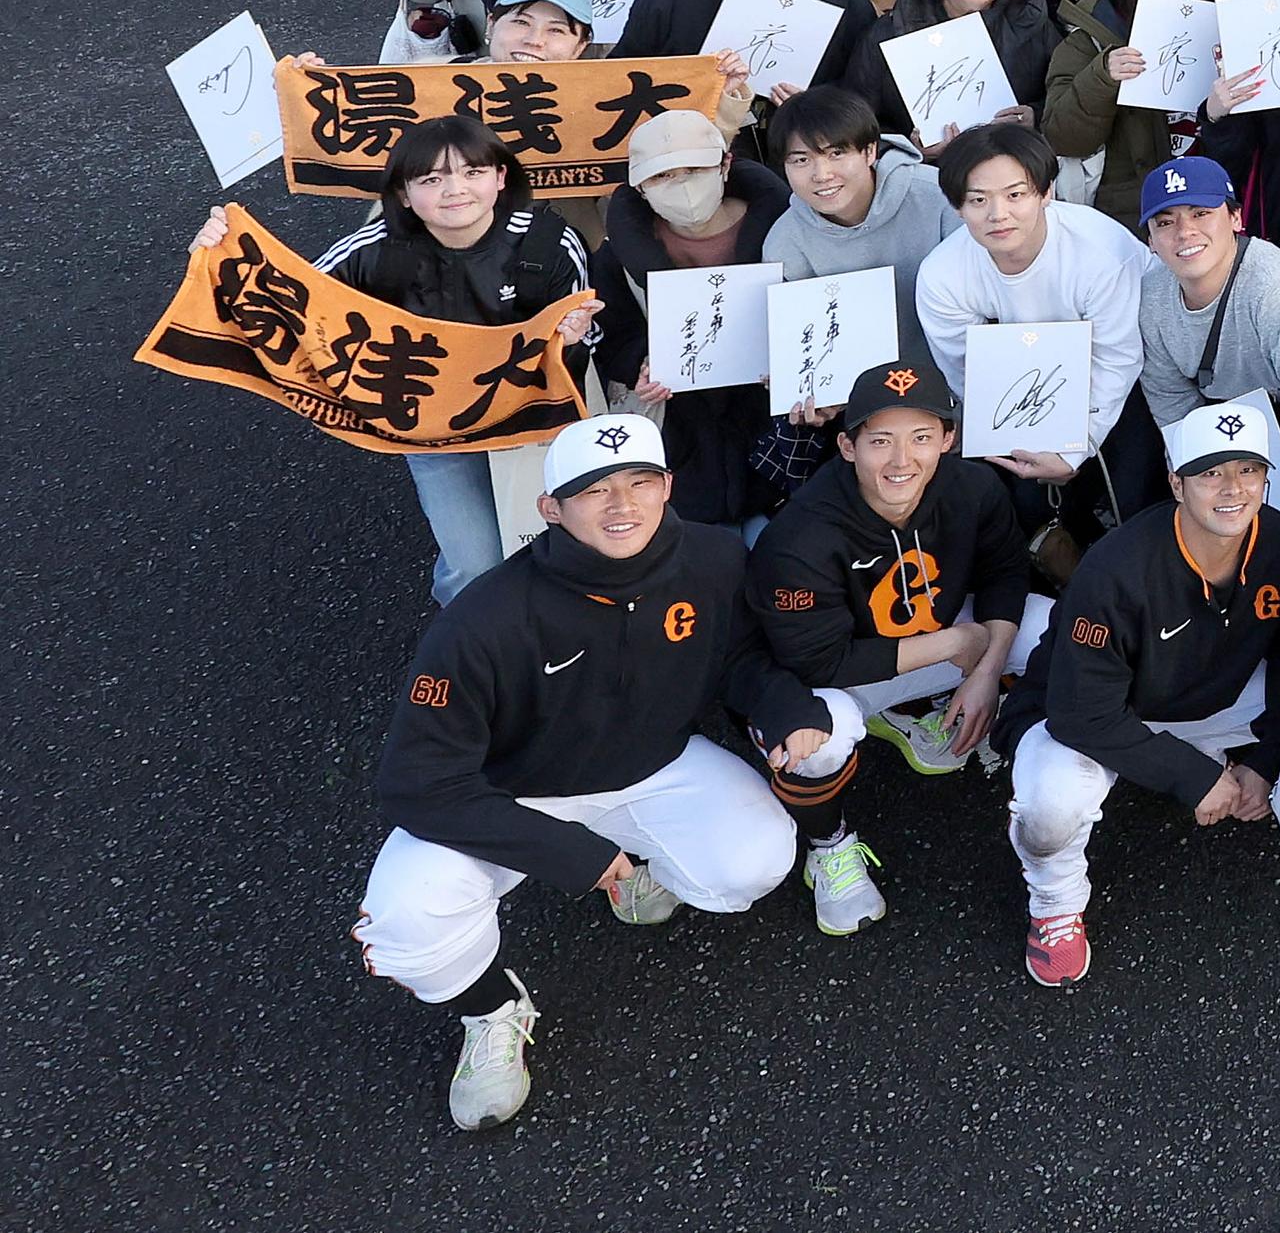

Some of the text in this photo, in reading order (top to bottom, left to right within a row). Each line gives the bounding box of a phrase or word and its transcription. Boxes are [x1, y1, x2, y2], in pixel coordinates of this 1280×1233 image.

[304, 69, 691, 156] 湯浅大
[1164, 168, 1188, 193] LA
[212, 230, 551, 432] 湯浅大
[774, 586, 815, 612] 32
[868, 549, 942, 638] G
[1253, 584, 1280, 621] G
[663, 601, 696, 642] G
[1071, 617, 1109, 649] 00
[410, 673, 450, 709] 61
